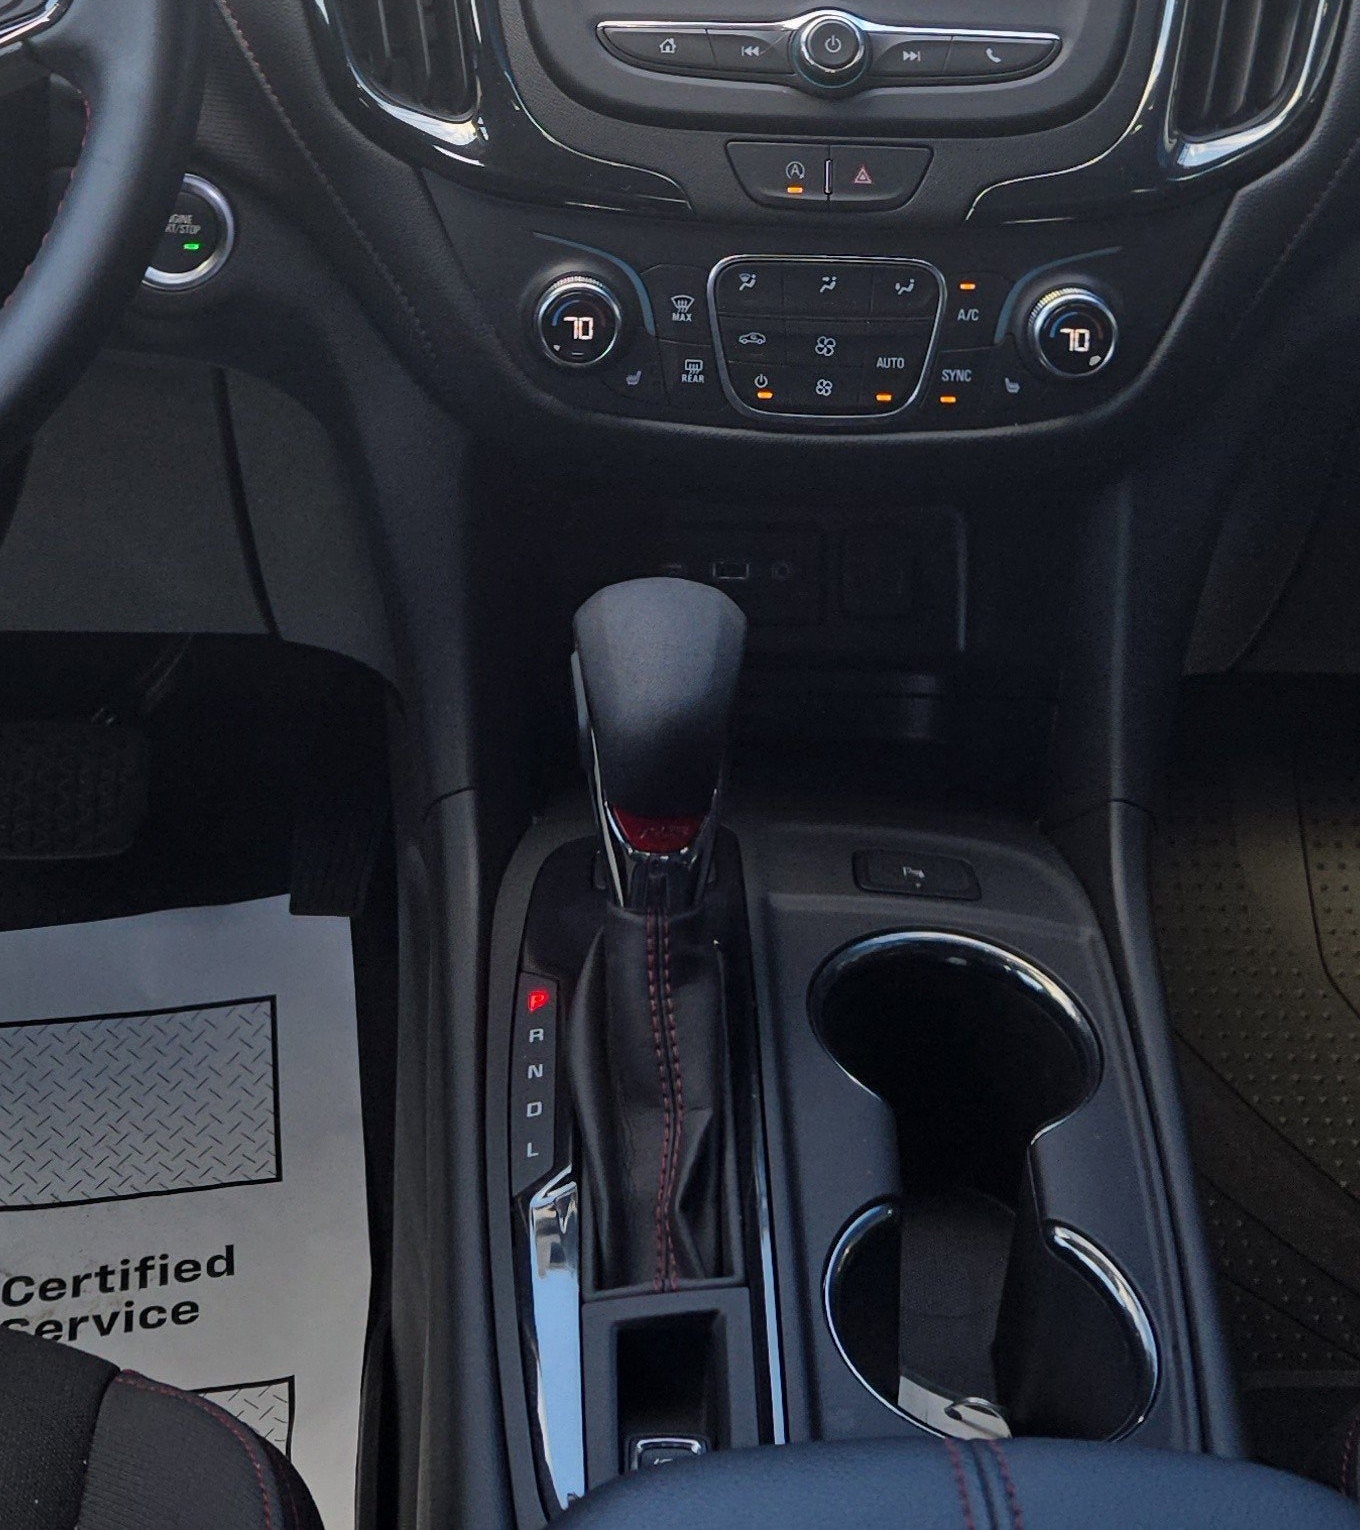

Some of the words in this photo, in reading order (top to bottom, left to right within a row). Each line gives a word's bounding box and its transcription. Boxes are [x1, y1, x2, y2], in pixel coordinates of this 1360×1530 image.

[672, 313, 692, 322] MAX
[957, 309, 979, 321] A/C
[563, 316, 594, 340] 70
[1060, 328, 1090, 352] 70
[876, 357, 905, 369] AUTO
[682, 374, 705, 383] REAR
[942, 370, 972, 382] SYNC
[528, 991, 548, 1011] P
[529, 1028, 544, 1043] R
[528, 1063, 544, 1079] N
[526, 1101, 543, 1118] D
[526, 1142, 539, 1157] L
[2, 1244, 235, 1307] Certified
